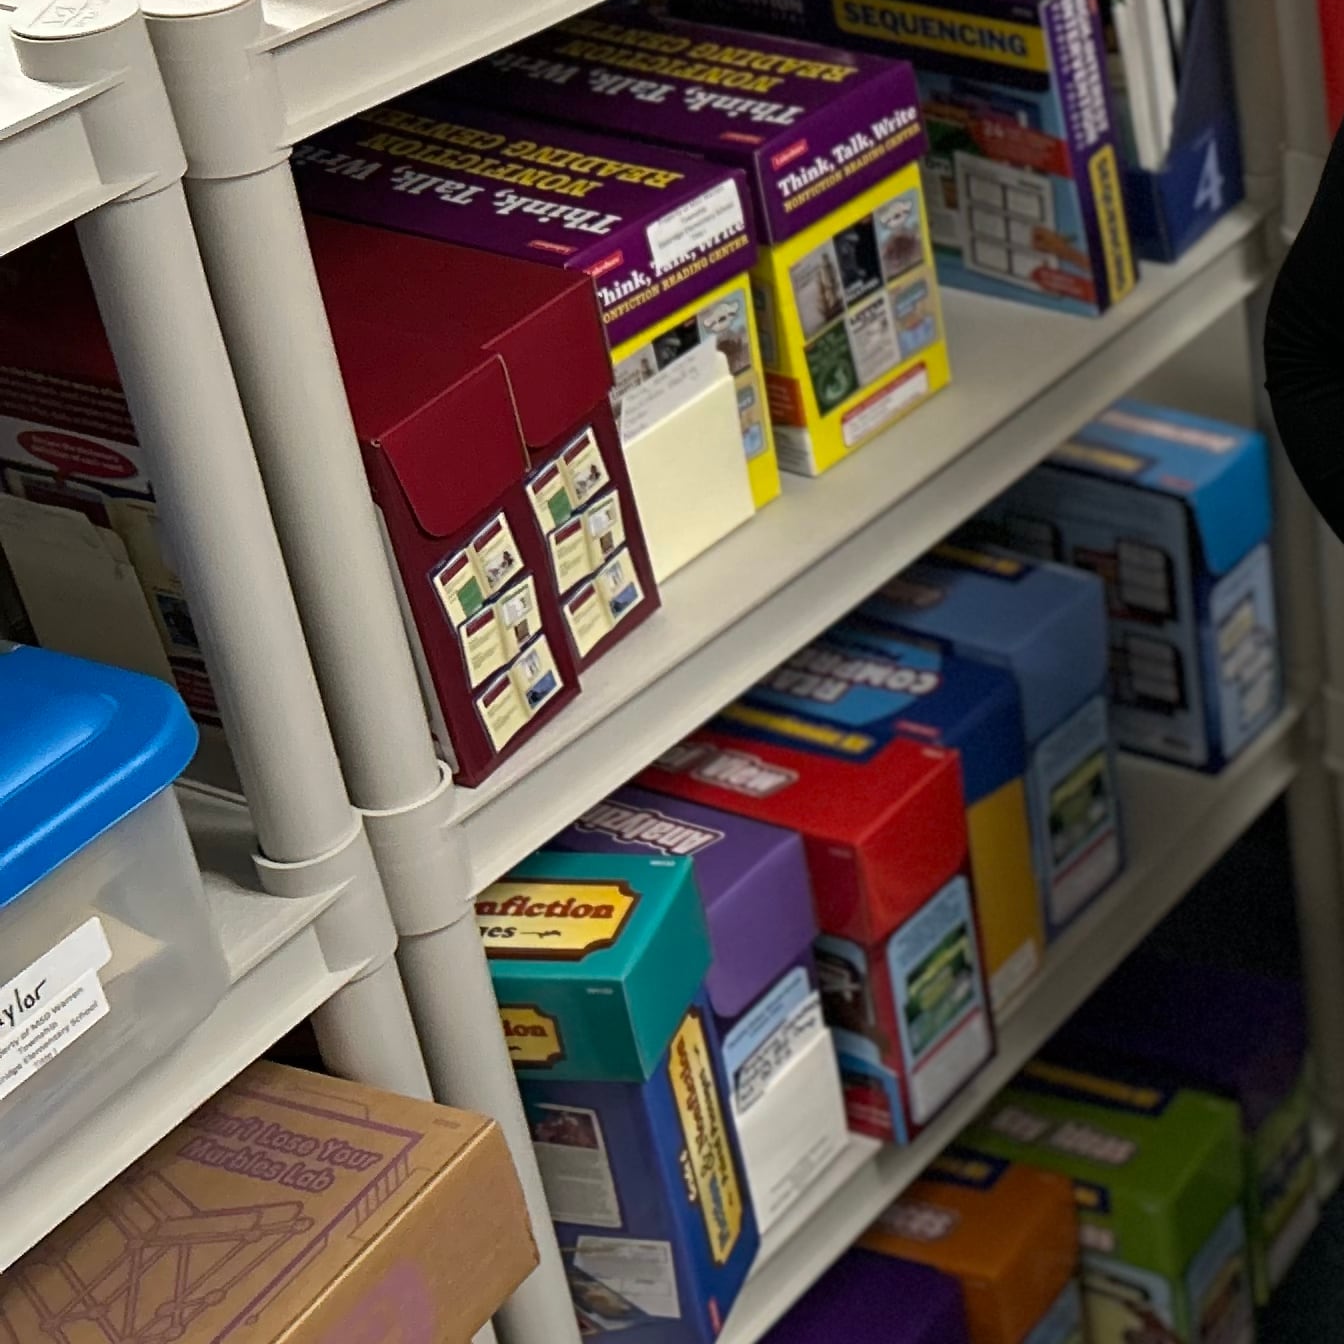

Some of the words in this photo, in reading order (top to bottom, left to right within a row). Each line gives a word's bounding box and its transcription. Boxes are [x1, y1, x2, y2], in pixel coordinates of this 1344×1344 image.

[842, 2, 1028, 57] SEQUENCING
[777, 169, 829, 198] Think,
[832, 138, 868, 168] Talk,
[868, 103, 917, 136] Write
[1193, 131, 1224, 212] 4
